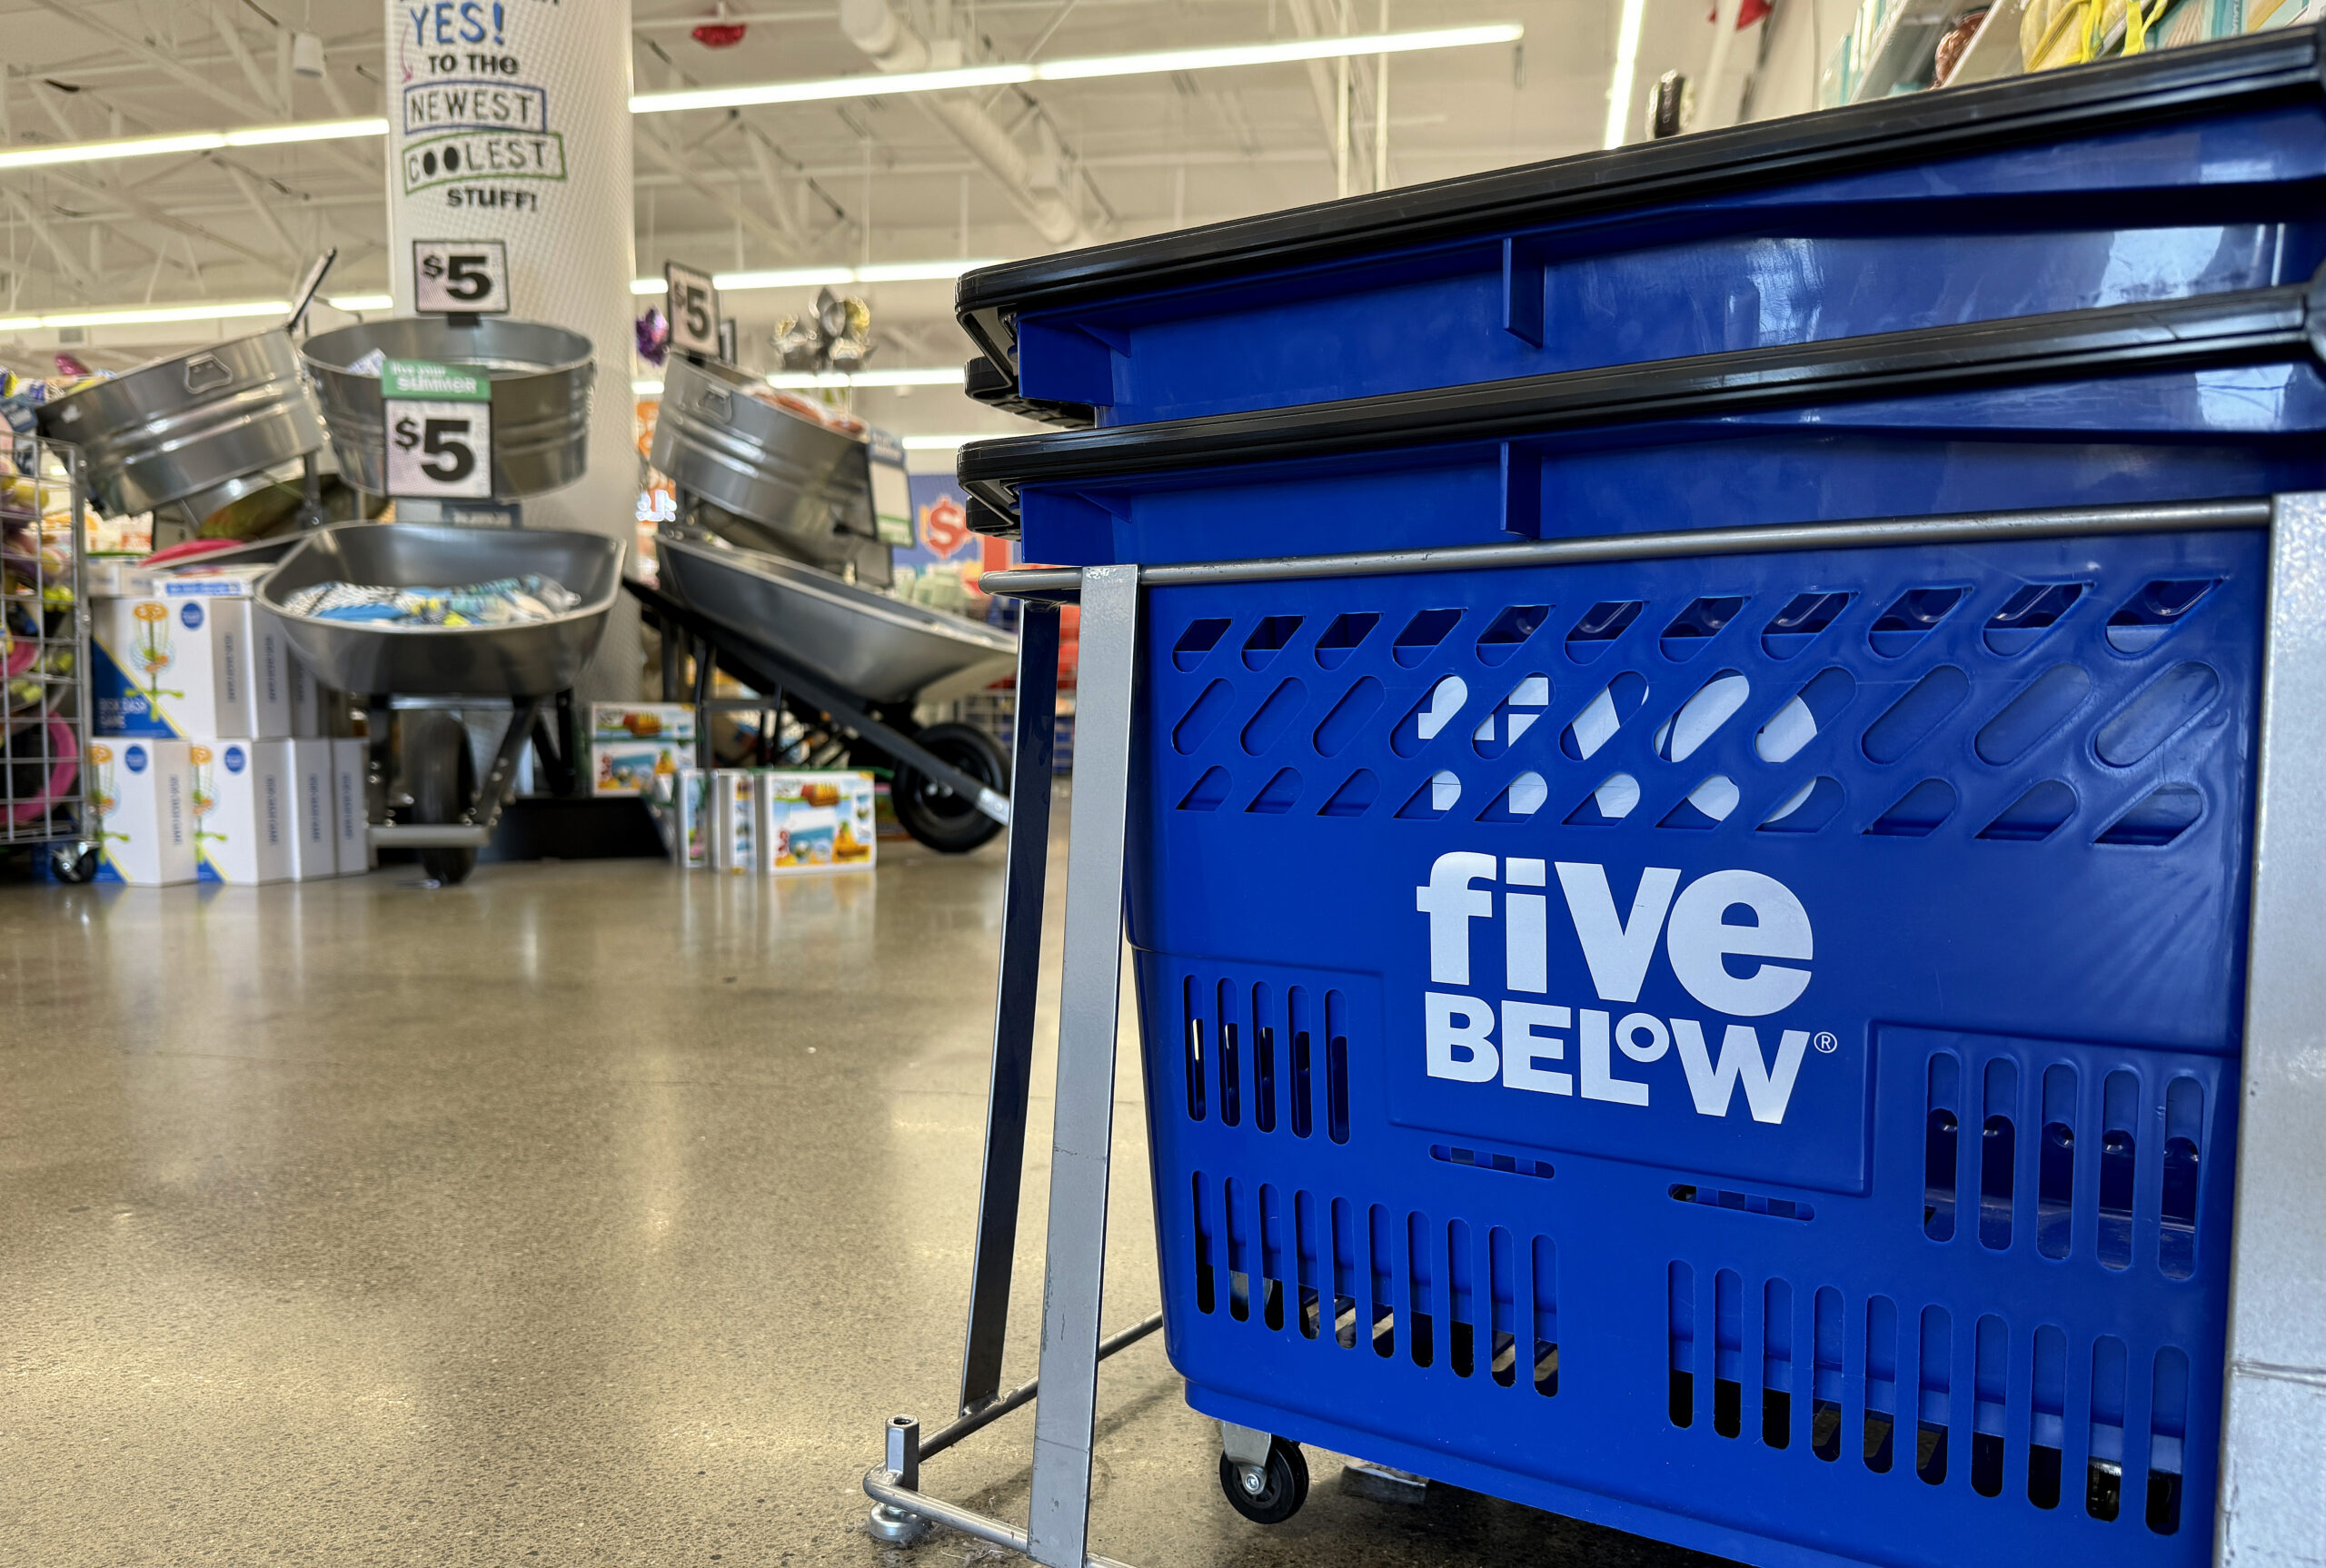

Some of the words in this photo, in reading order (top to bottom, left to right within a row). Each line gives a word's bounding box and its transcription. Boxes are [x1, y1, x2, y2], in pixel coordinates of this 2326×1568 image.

[410, 2, 505, 46] YES!
[428, 55, 457, 74] TO
[410, 90, 534, 124] NEWEST
[408, 140, 546, 184] COOLEST
[446, 187, 538, 213] STUFF!
[422, 254, 492, 301] $5
[673, 282, 712, 339] $5
[394, 415, 476, 482] $5
[1416, 851, 1814, 1017] five
